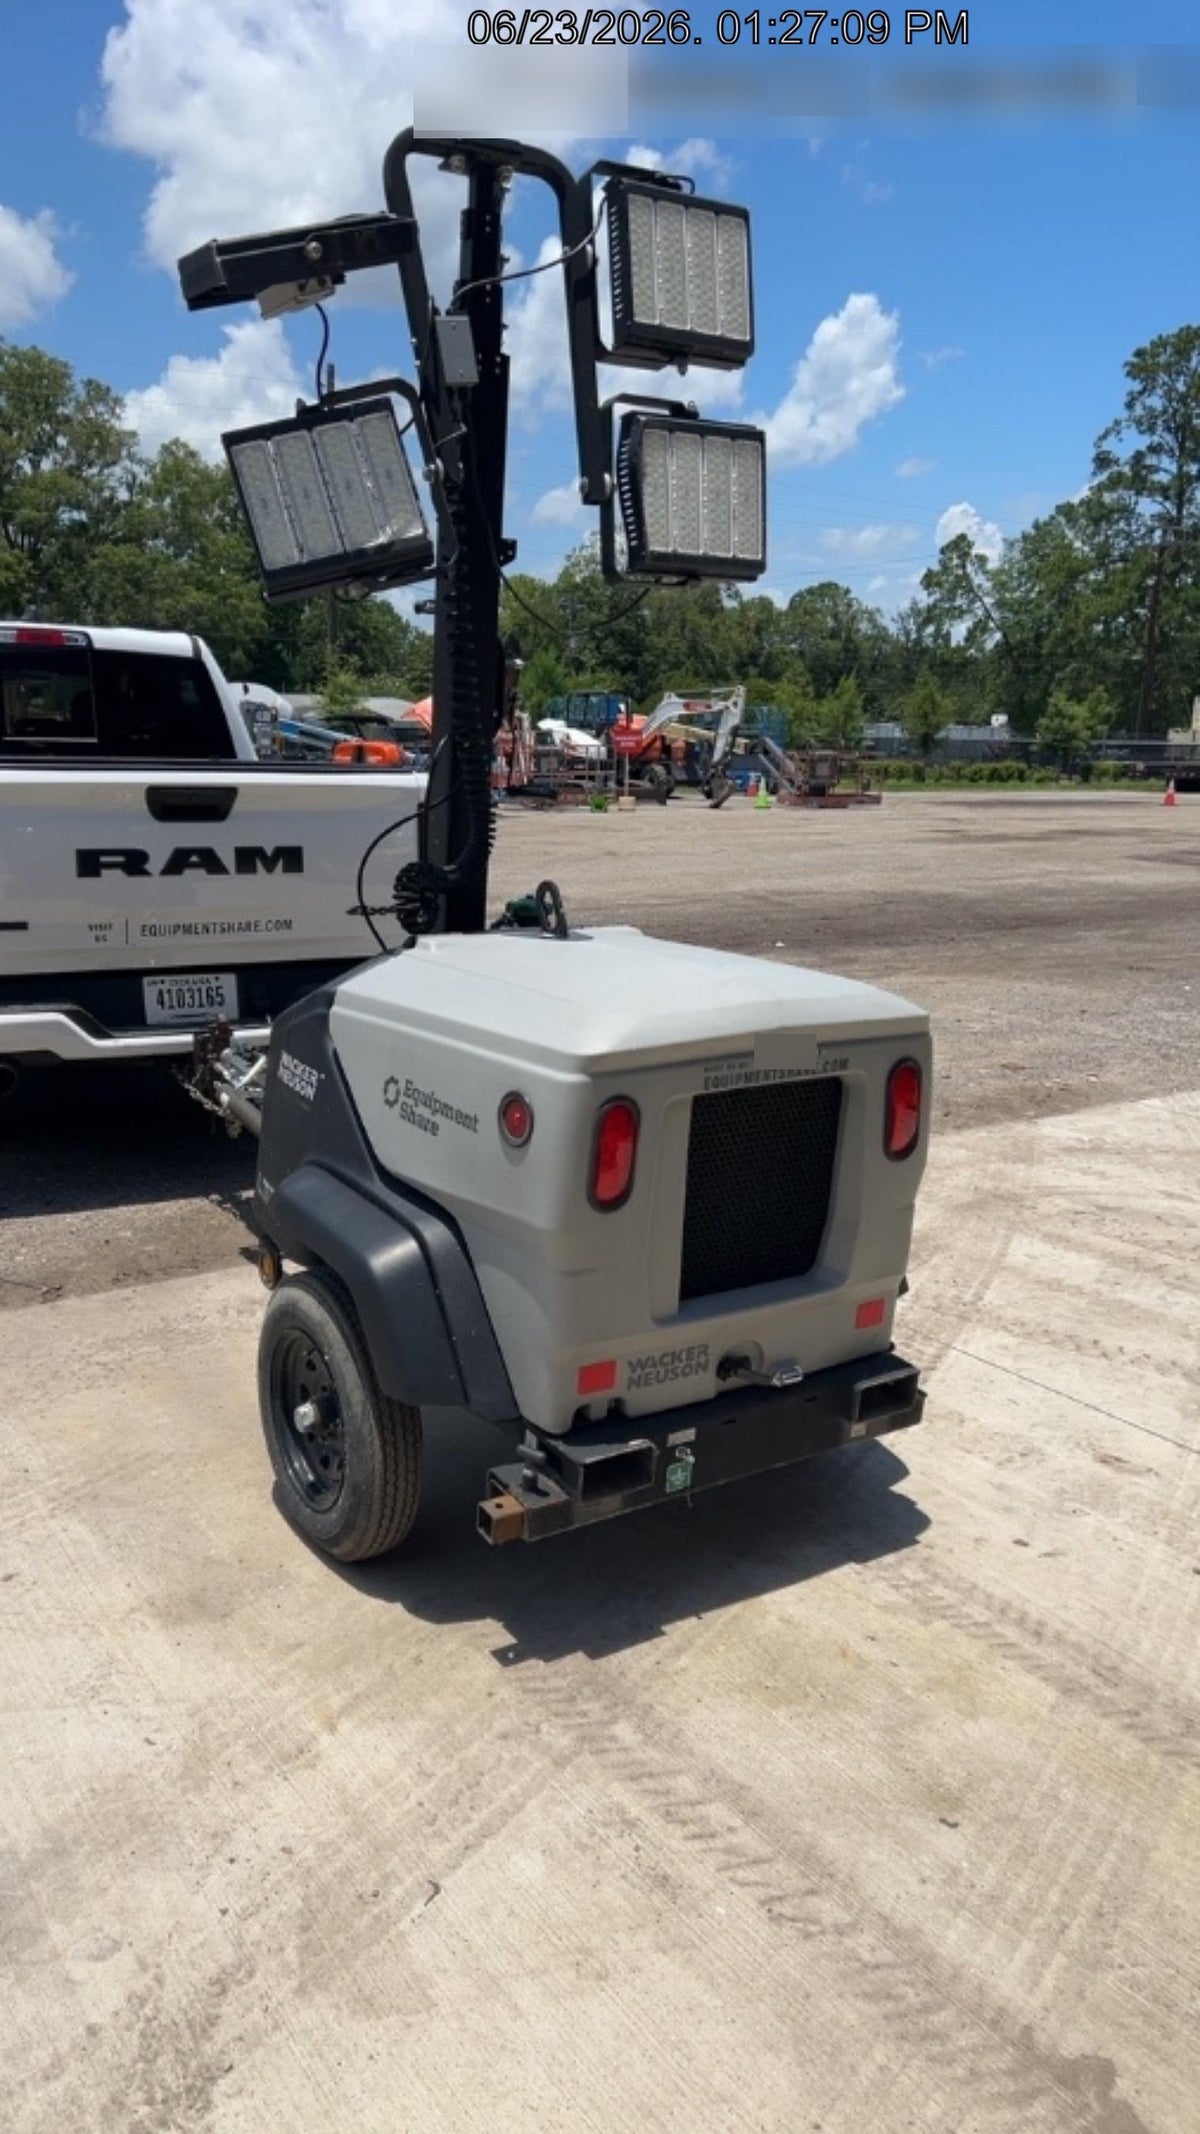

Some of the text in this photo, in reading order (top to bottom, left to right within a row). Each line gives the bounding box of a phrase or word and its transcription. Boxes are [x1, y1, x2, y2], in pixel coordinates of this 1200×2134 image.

[75, 844, 304, 879] RAM
[140, 919, 293, 937] EQUIPMENTSHARE.COM
[156, 986, 226, 1010] 4103165
[280, 1050, 319, 1081] WACKER
[277, 1070, 316, 1101] NEUSON
[400, 1101, 439, 1137] Share
[403, 1078, 479, 1134] Equipment
[627, 1344, 710, 1374] WACKER
[626, 1360, 710, 1392] NEUSON
